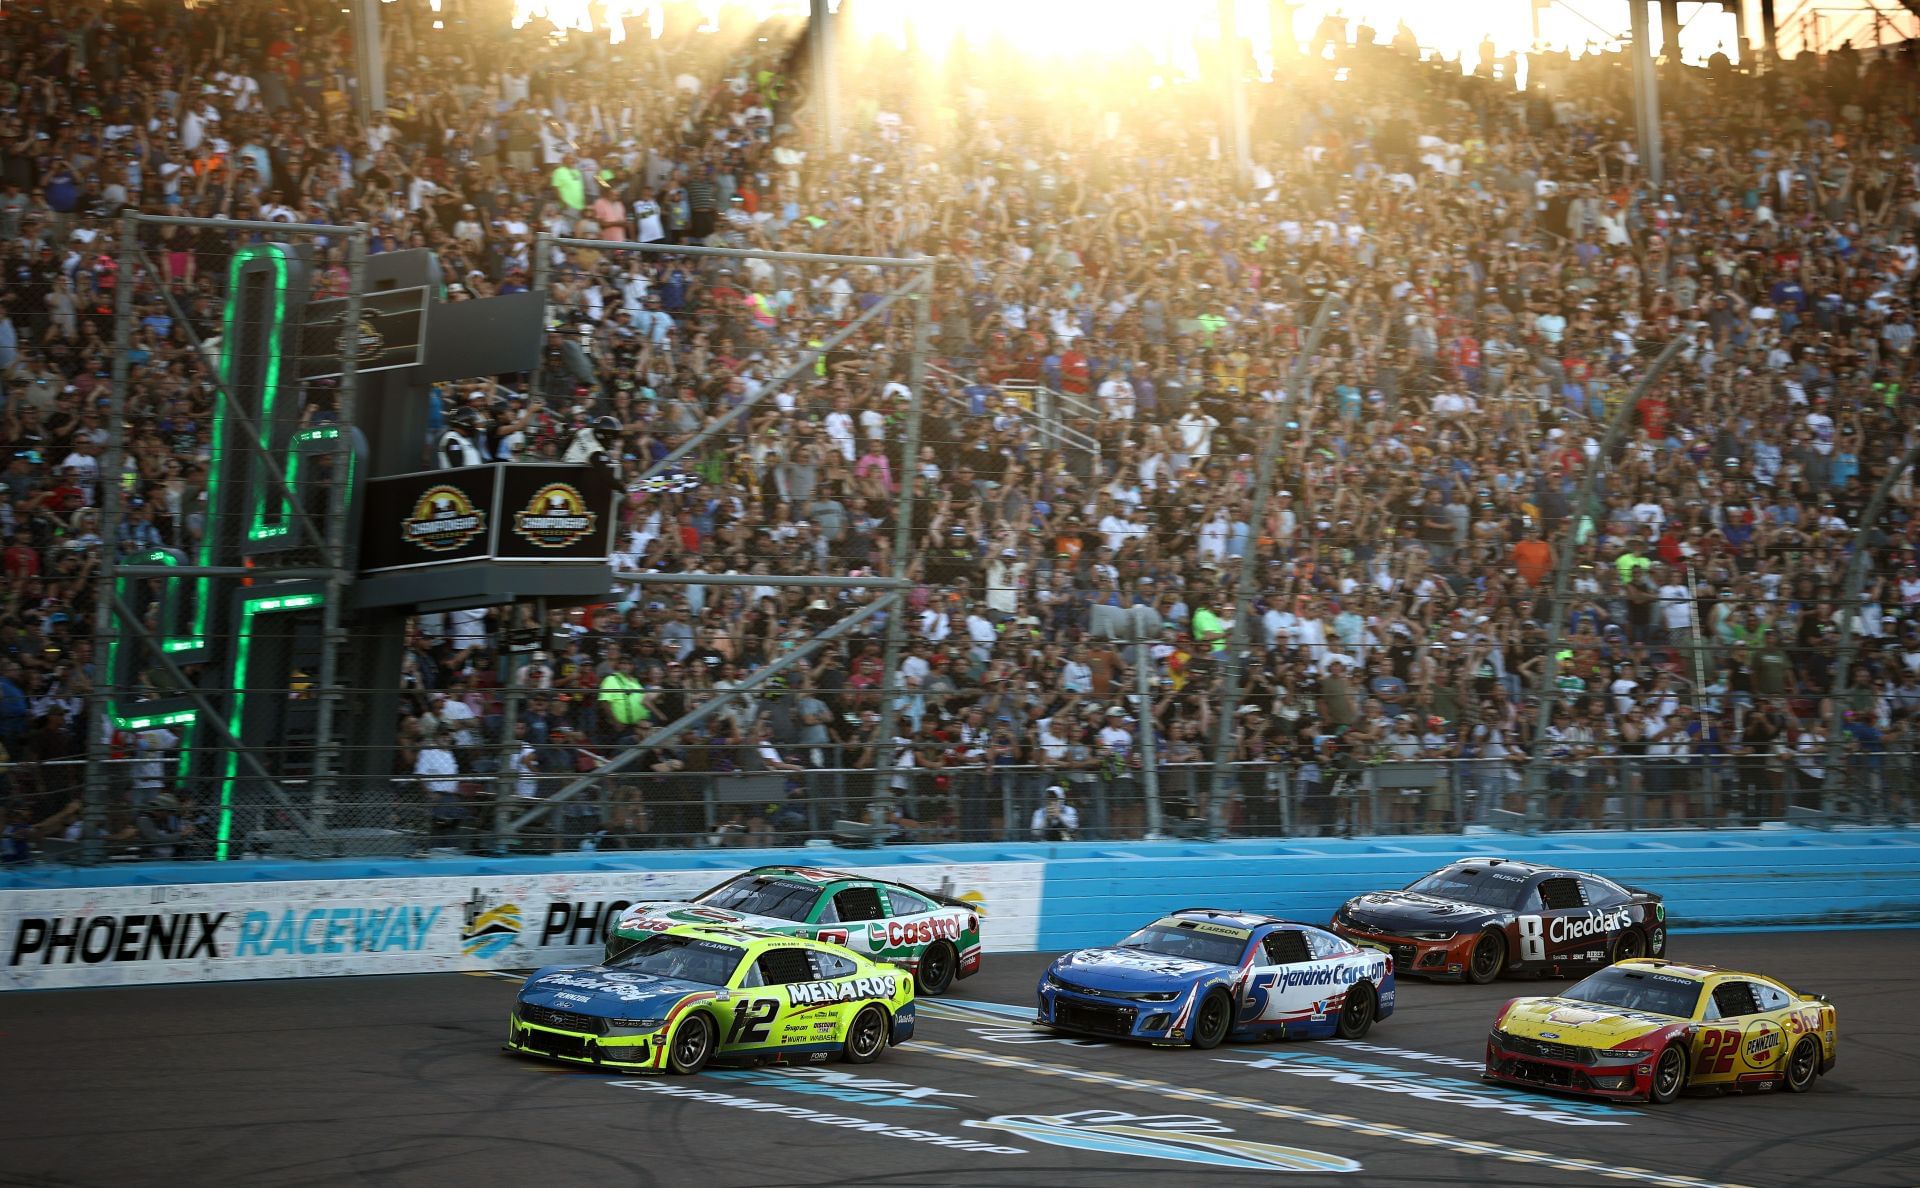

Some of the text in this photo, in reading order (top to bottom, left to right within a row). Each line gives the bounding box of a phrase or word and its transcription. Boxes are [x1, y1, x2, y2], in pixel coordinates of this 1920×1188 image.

[1492, 873, 1525, 884] BUSCH
[8, 903, 443, 967] PHOENIX RACEWAY
[887, 913, 961, 947] Castrol
[1200, 925, 1239, 936] LARSON
[1517, 915, 1546, 961] 8
[1549, 905, 1632, 943] Cheddar's
[786, 976, 897, 1007] MENARDS
[1652, 974, 1692, 985] LOGANO
[553, 991, 591, 1003] PENNZOIL
[1239, 973, 1278, 1023] 5
[724, 998, 780, 1045] 12
[1789, 1007, 1825, 1034] Shell
[1694, 1029, 1742, 1074] 22
[1746, 1032, 1780, 1056] PENNZOIL
[603, 1080, 1030, 1155] CHAMPIONSHIP
